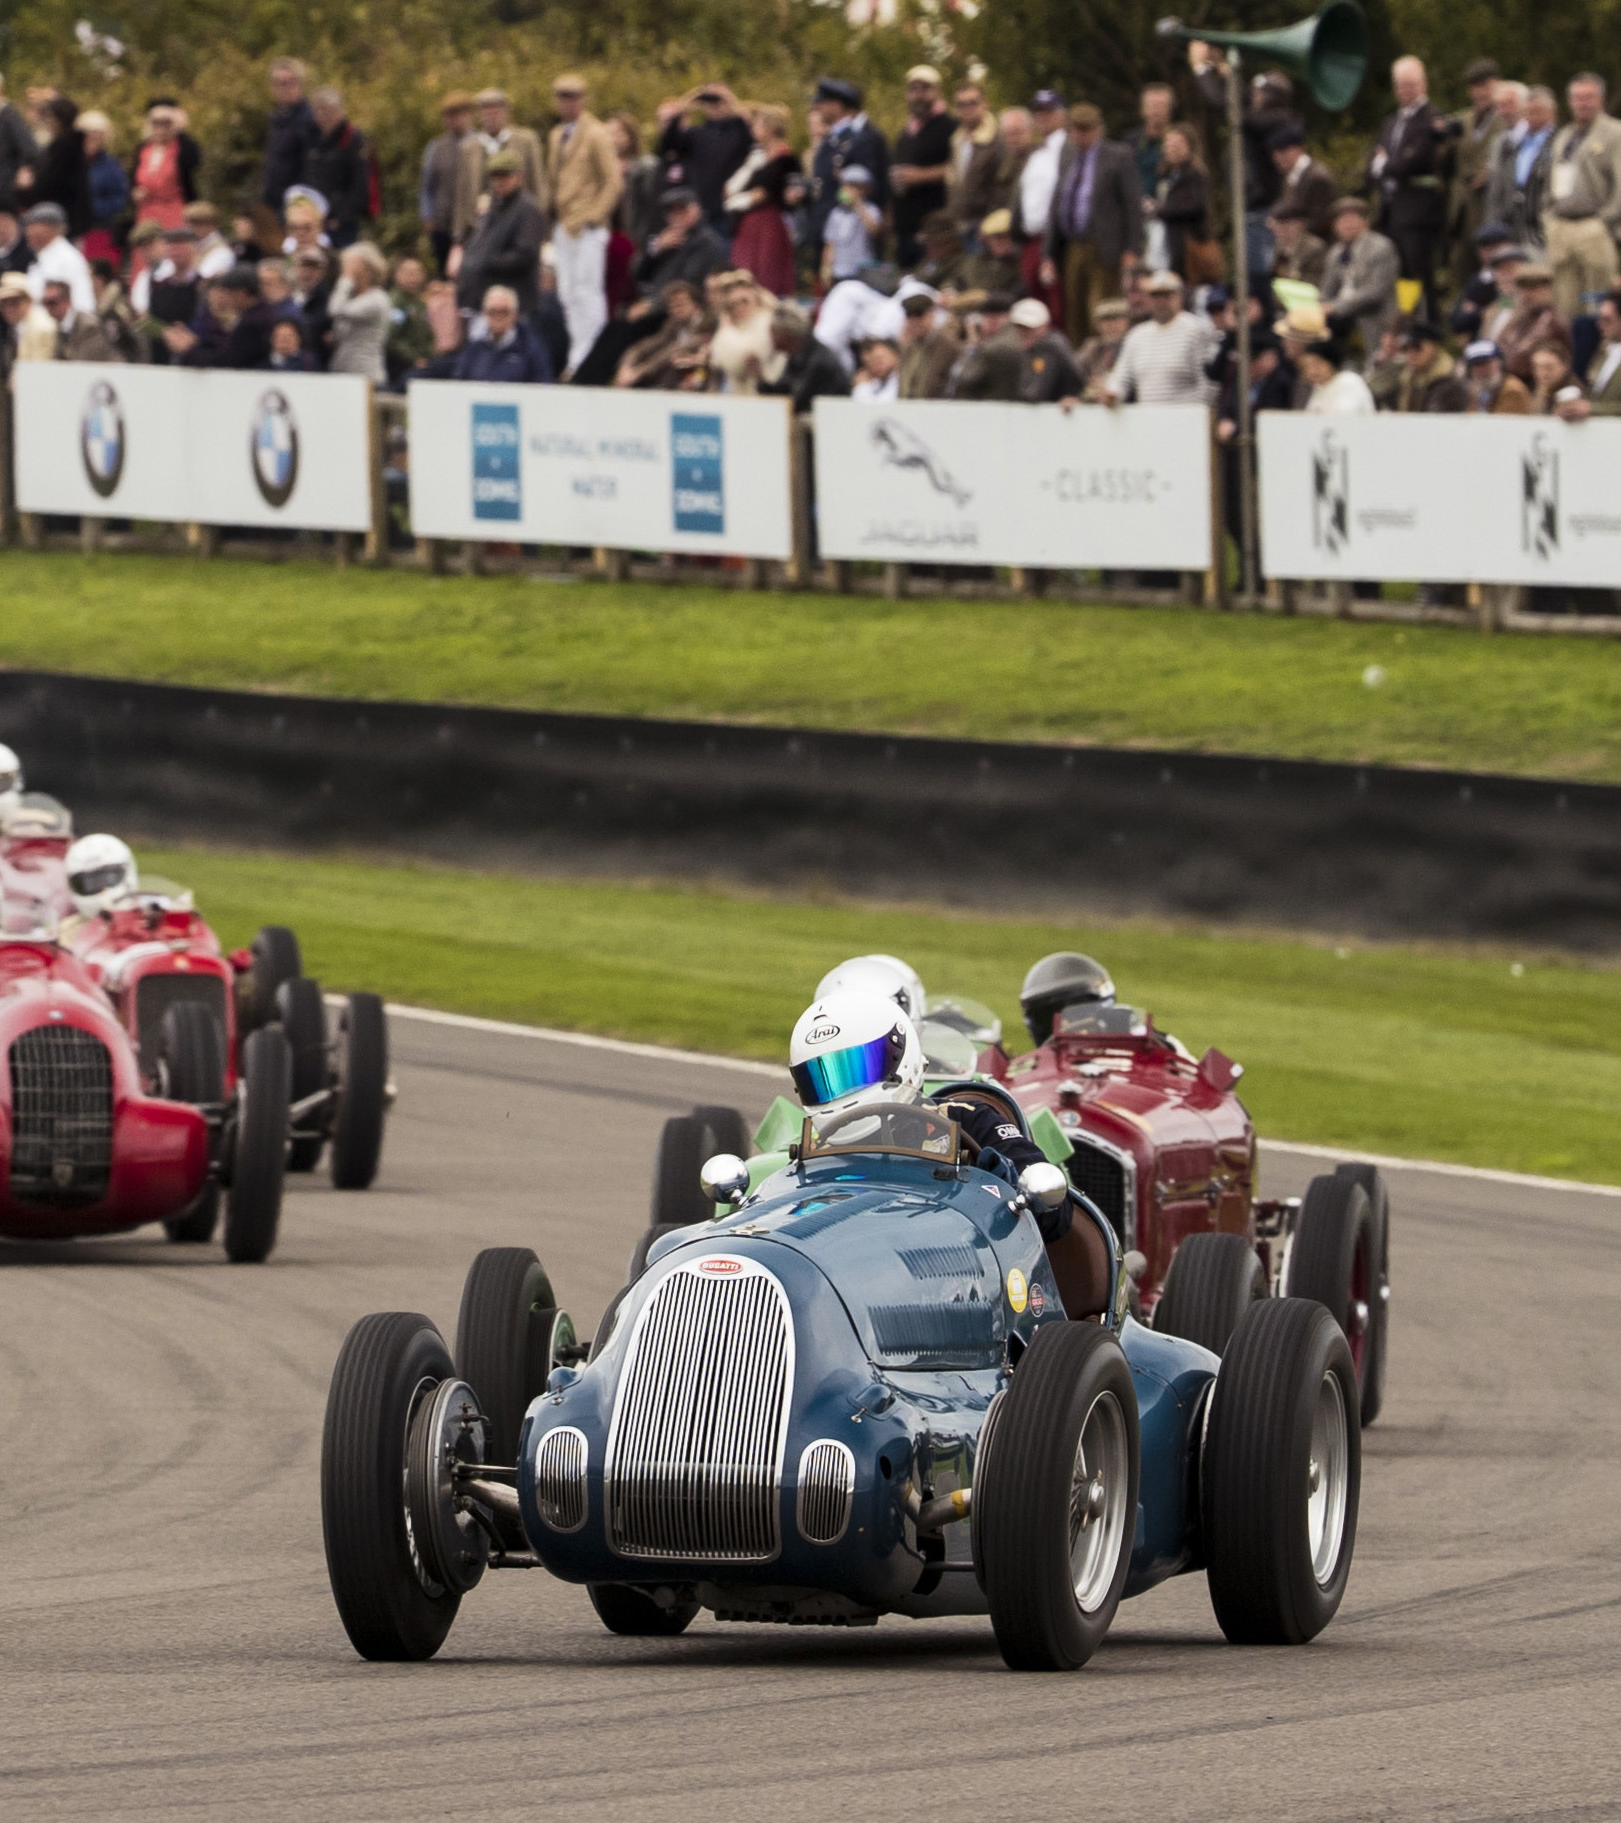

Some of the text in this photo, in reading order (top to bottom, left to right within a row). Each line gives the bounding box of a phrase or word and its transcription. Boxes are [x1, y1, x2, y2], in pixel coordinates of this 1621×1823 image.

[1056, 467, 1157, 503] CLASSIC
[860, 519, 979, 547] JAGUAR
[701, 1262, 739, 1271] BUGATTI
